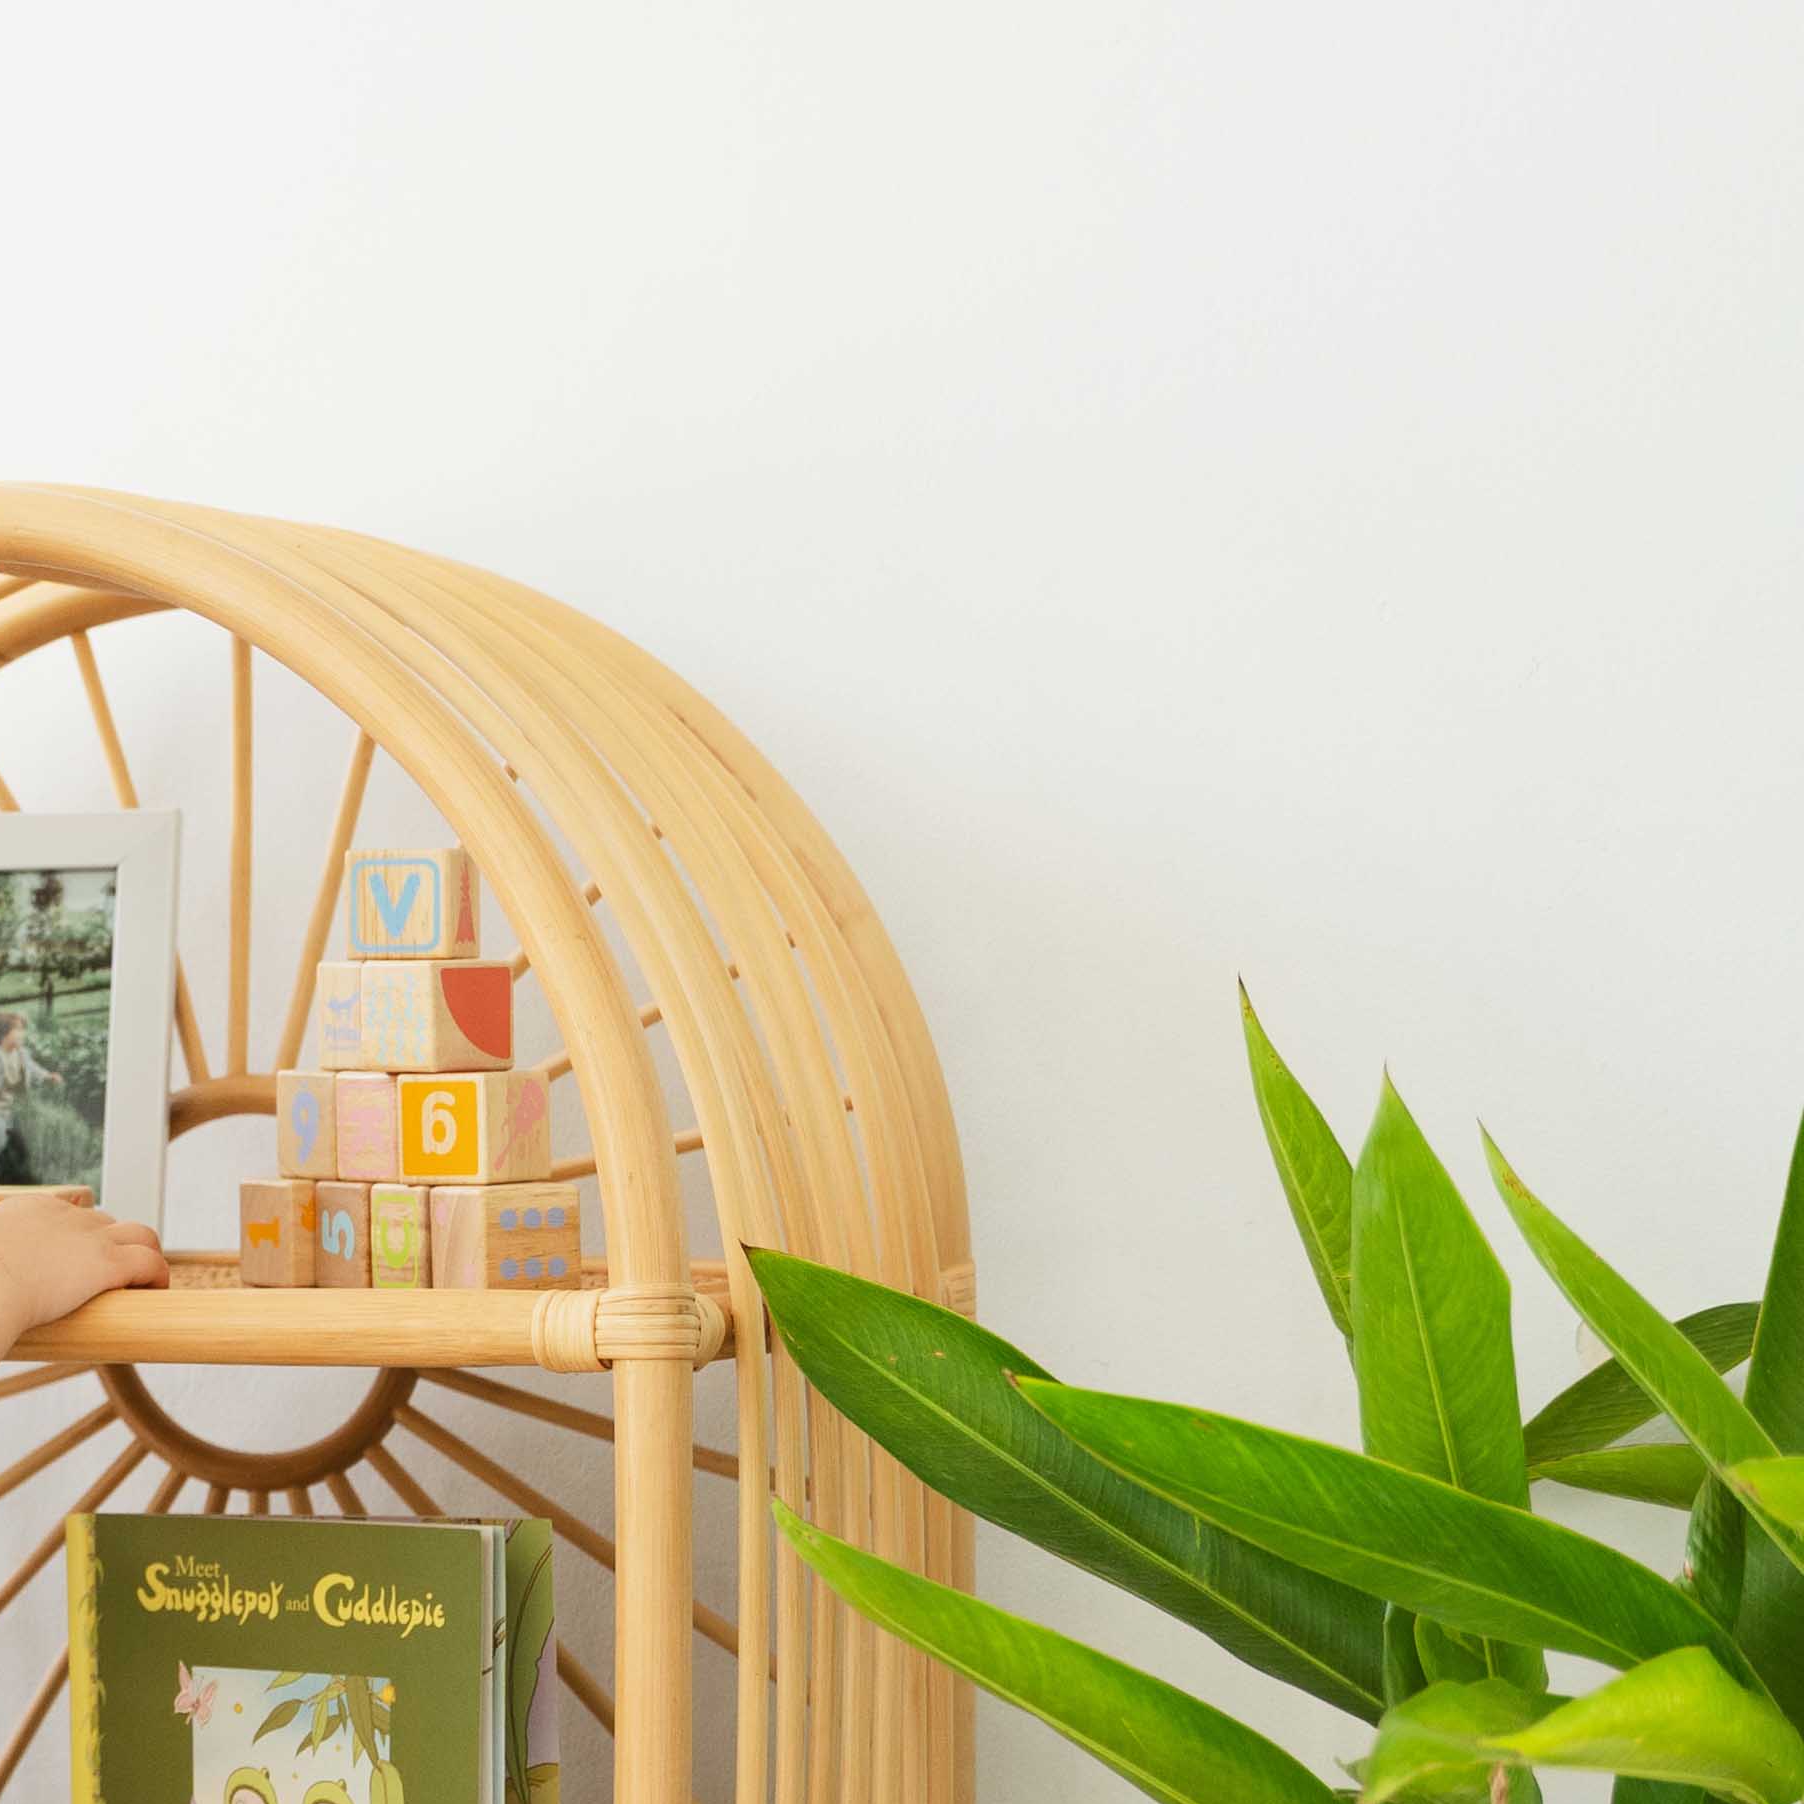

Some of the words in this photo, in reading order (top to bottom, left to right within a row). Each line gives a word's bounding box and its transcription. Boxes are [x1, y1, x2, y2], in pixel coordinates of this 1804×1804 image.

[368, 872, 421, 938] V
[420, 1090, 457, 1155] 6
[174, 1555, 221, 1578] Meet
[285, 1594, 310, 1613] and
[312, 1572, 445, 1639] Cuddlepie
